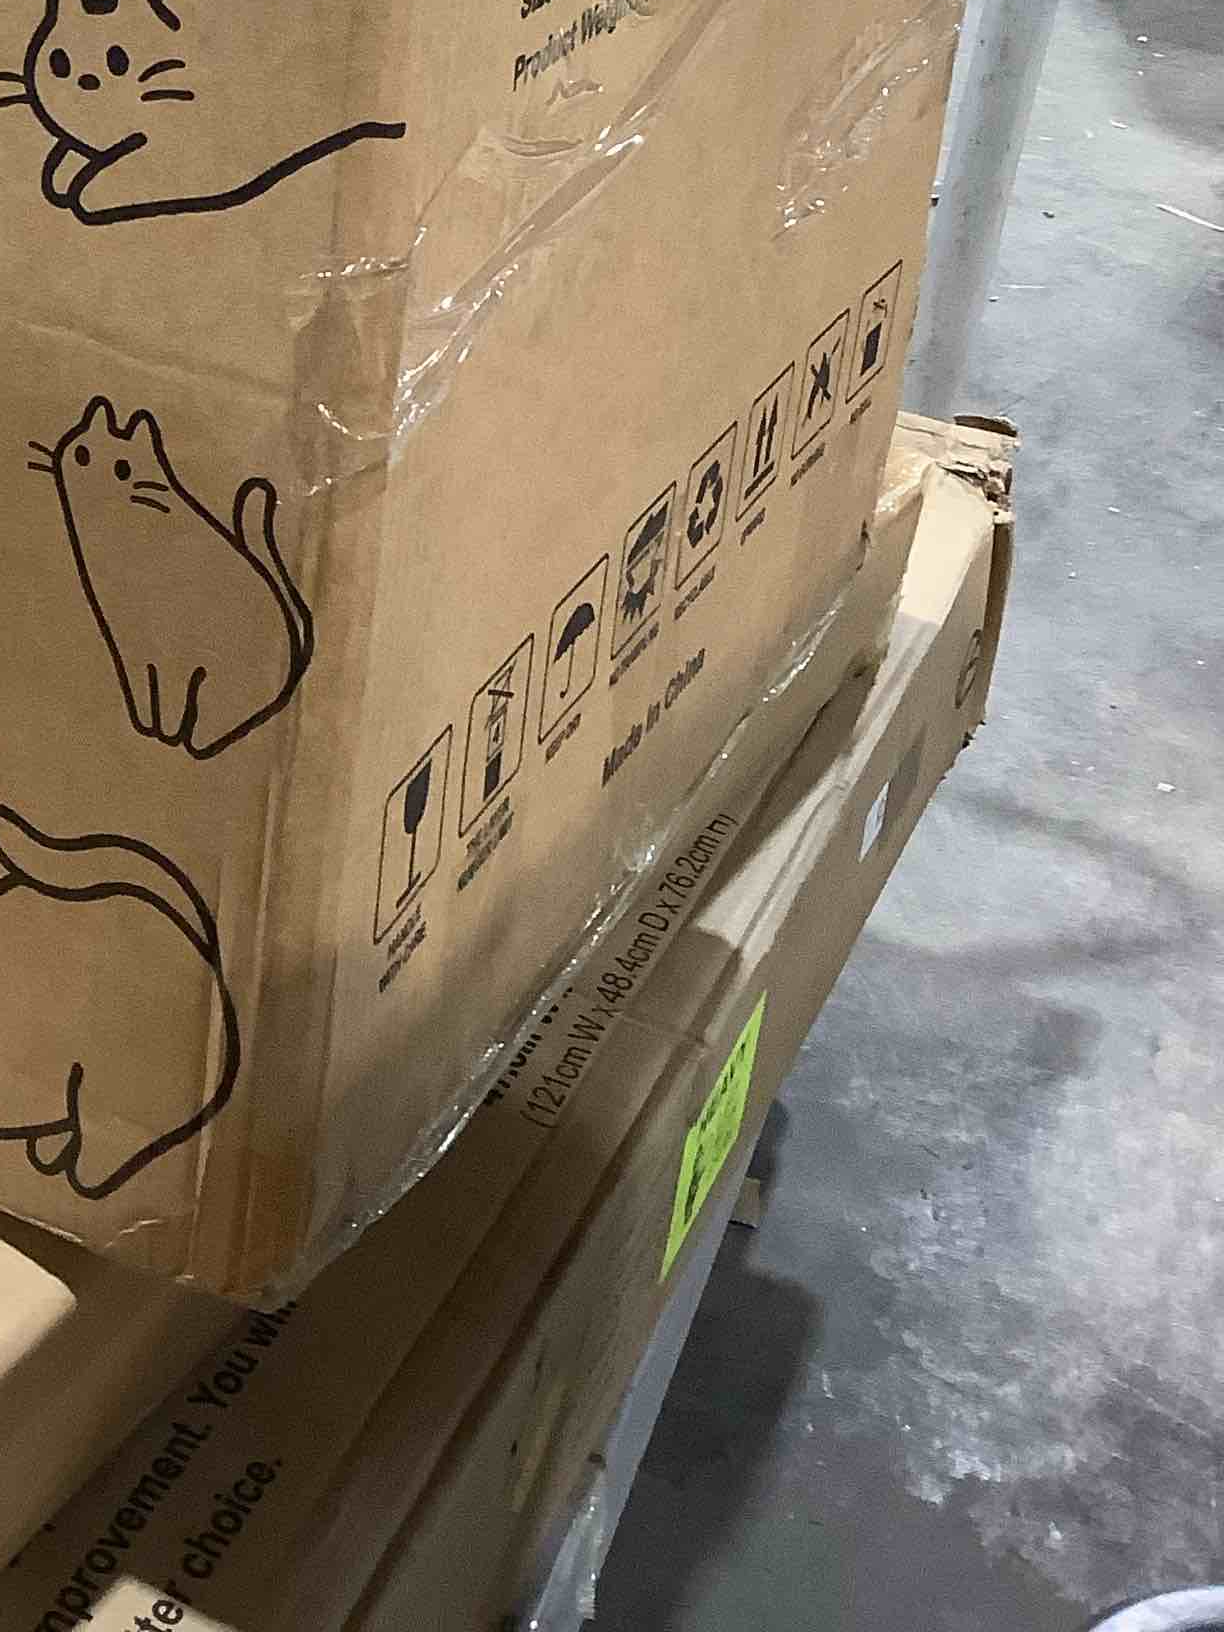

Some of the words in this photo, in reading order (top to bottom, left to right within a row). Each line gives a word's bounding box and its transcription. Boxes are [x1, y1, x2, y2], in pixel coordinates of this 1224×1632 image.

[658, 834, 721, 899] 76.2cm
[637, 911, 670, 933] D
[656, 898, 681, 915] x
[596, 932, 662, 1004] 48.4cm
[567, 1014, 606, 1043] W
[591, 1004, 624, 1018] x
[187, 1347, 260, 1410] You
[180, 1458, 284, 1582] choice.
